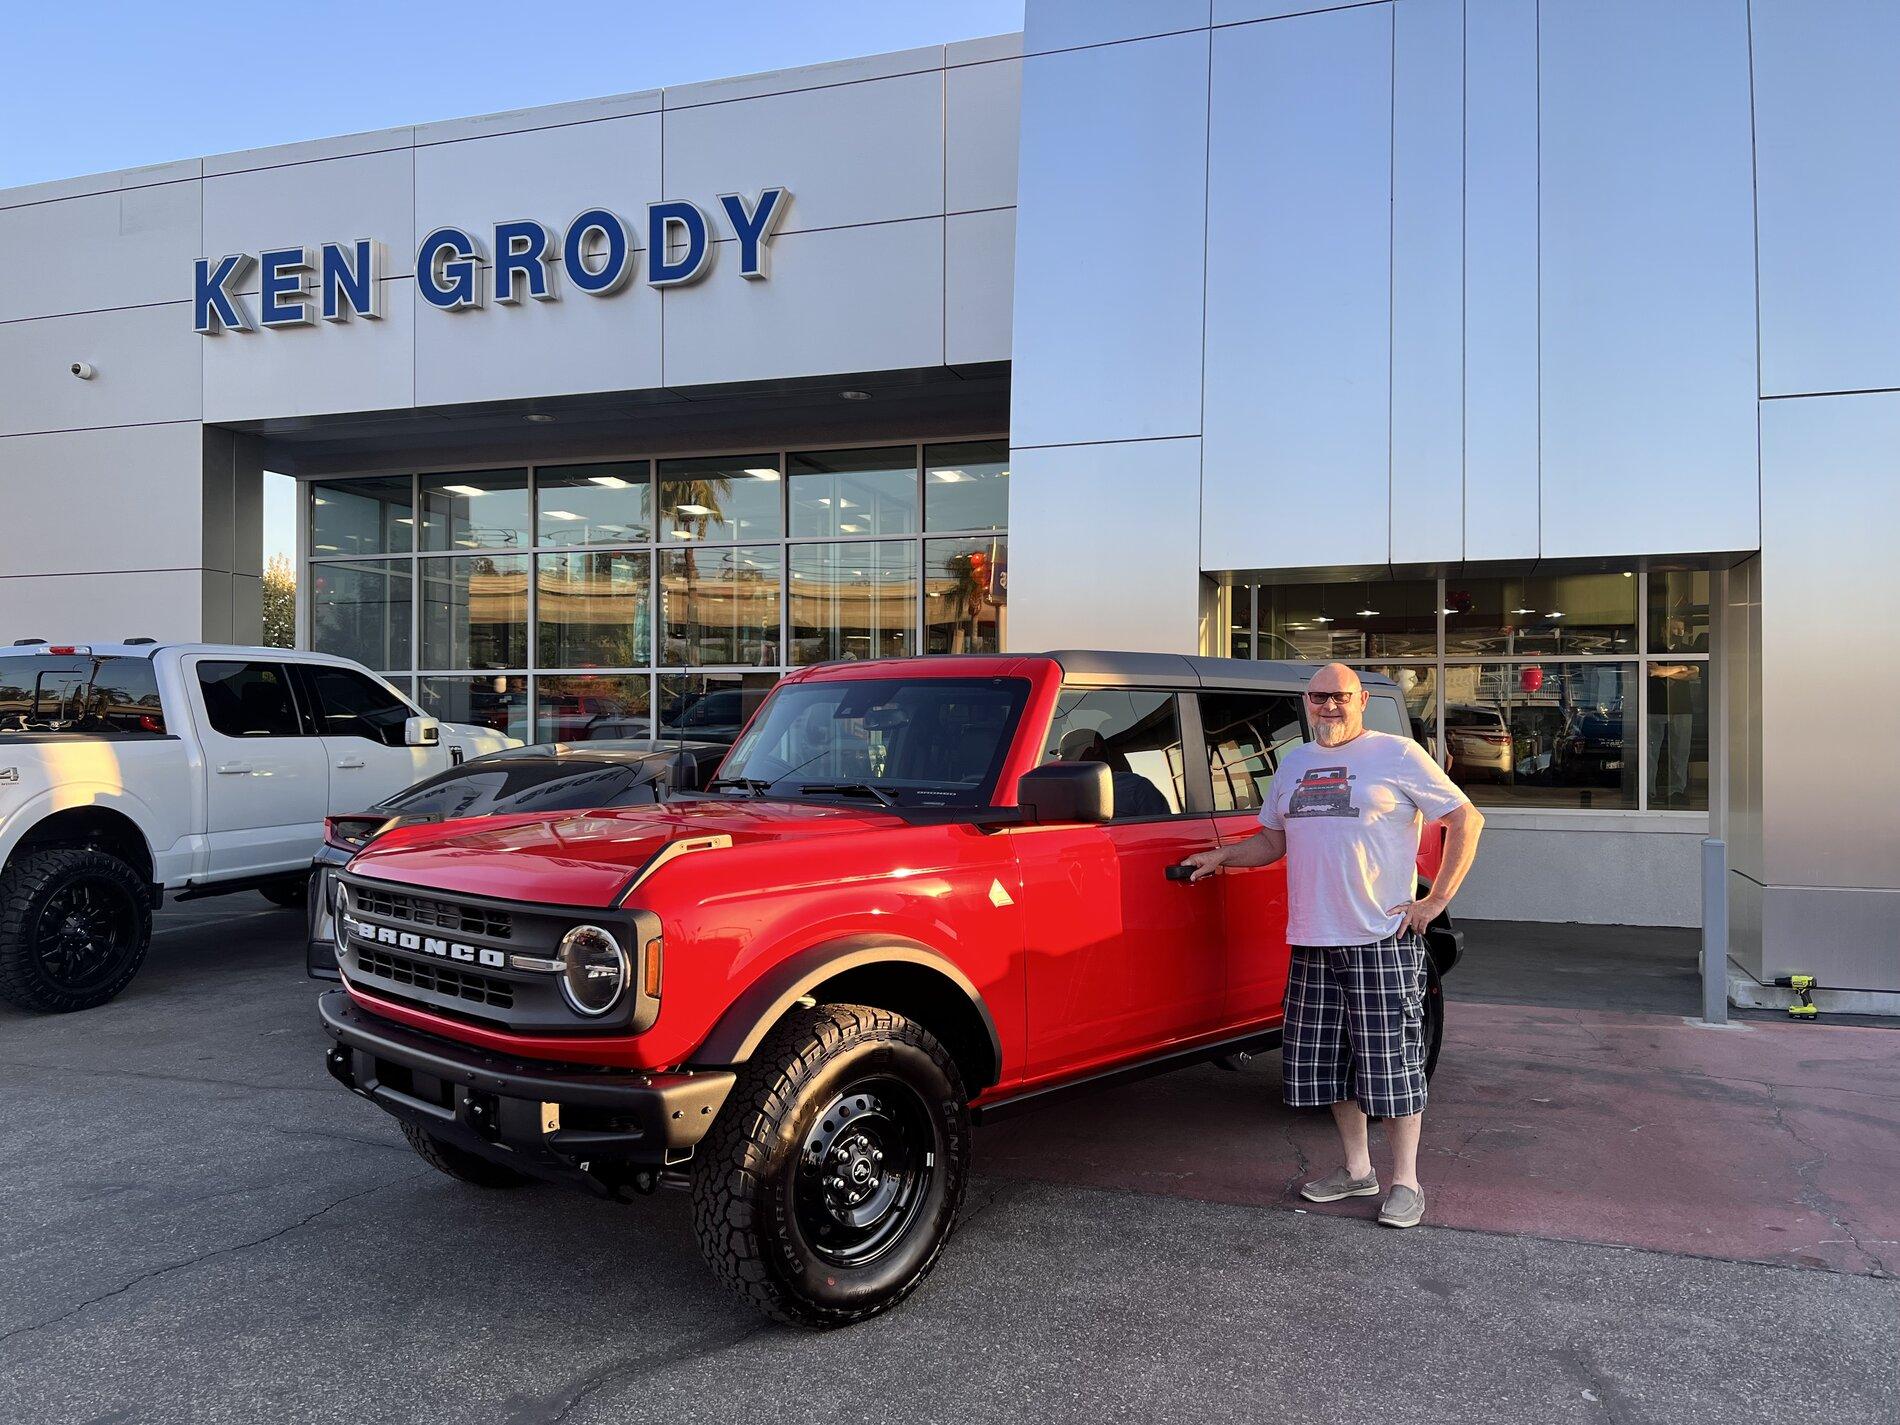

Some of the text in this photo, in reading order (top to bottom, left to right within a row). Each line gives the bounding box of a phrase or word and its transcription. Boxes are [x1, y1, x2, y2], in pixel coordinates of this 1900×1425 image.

[193, 186, 792, 335] KEN GRODY
[358, 922, 505, 968] BRONCO
